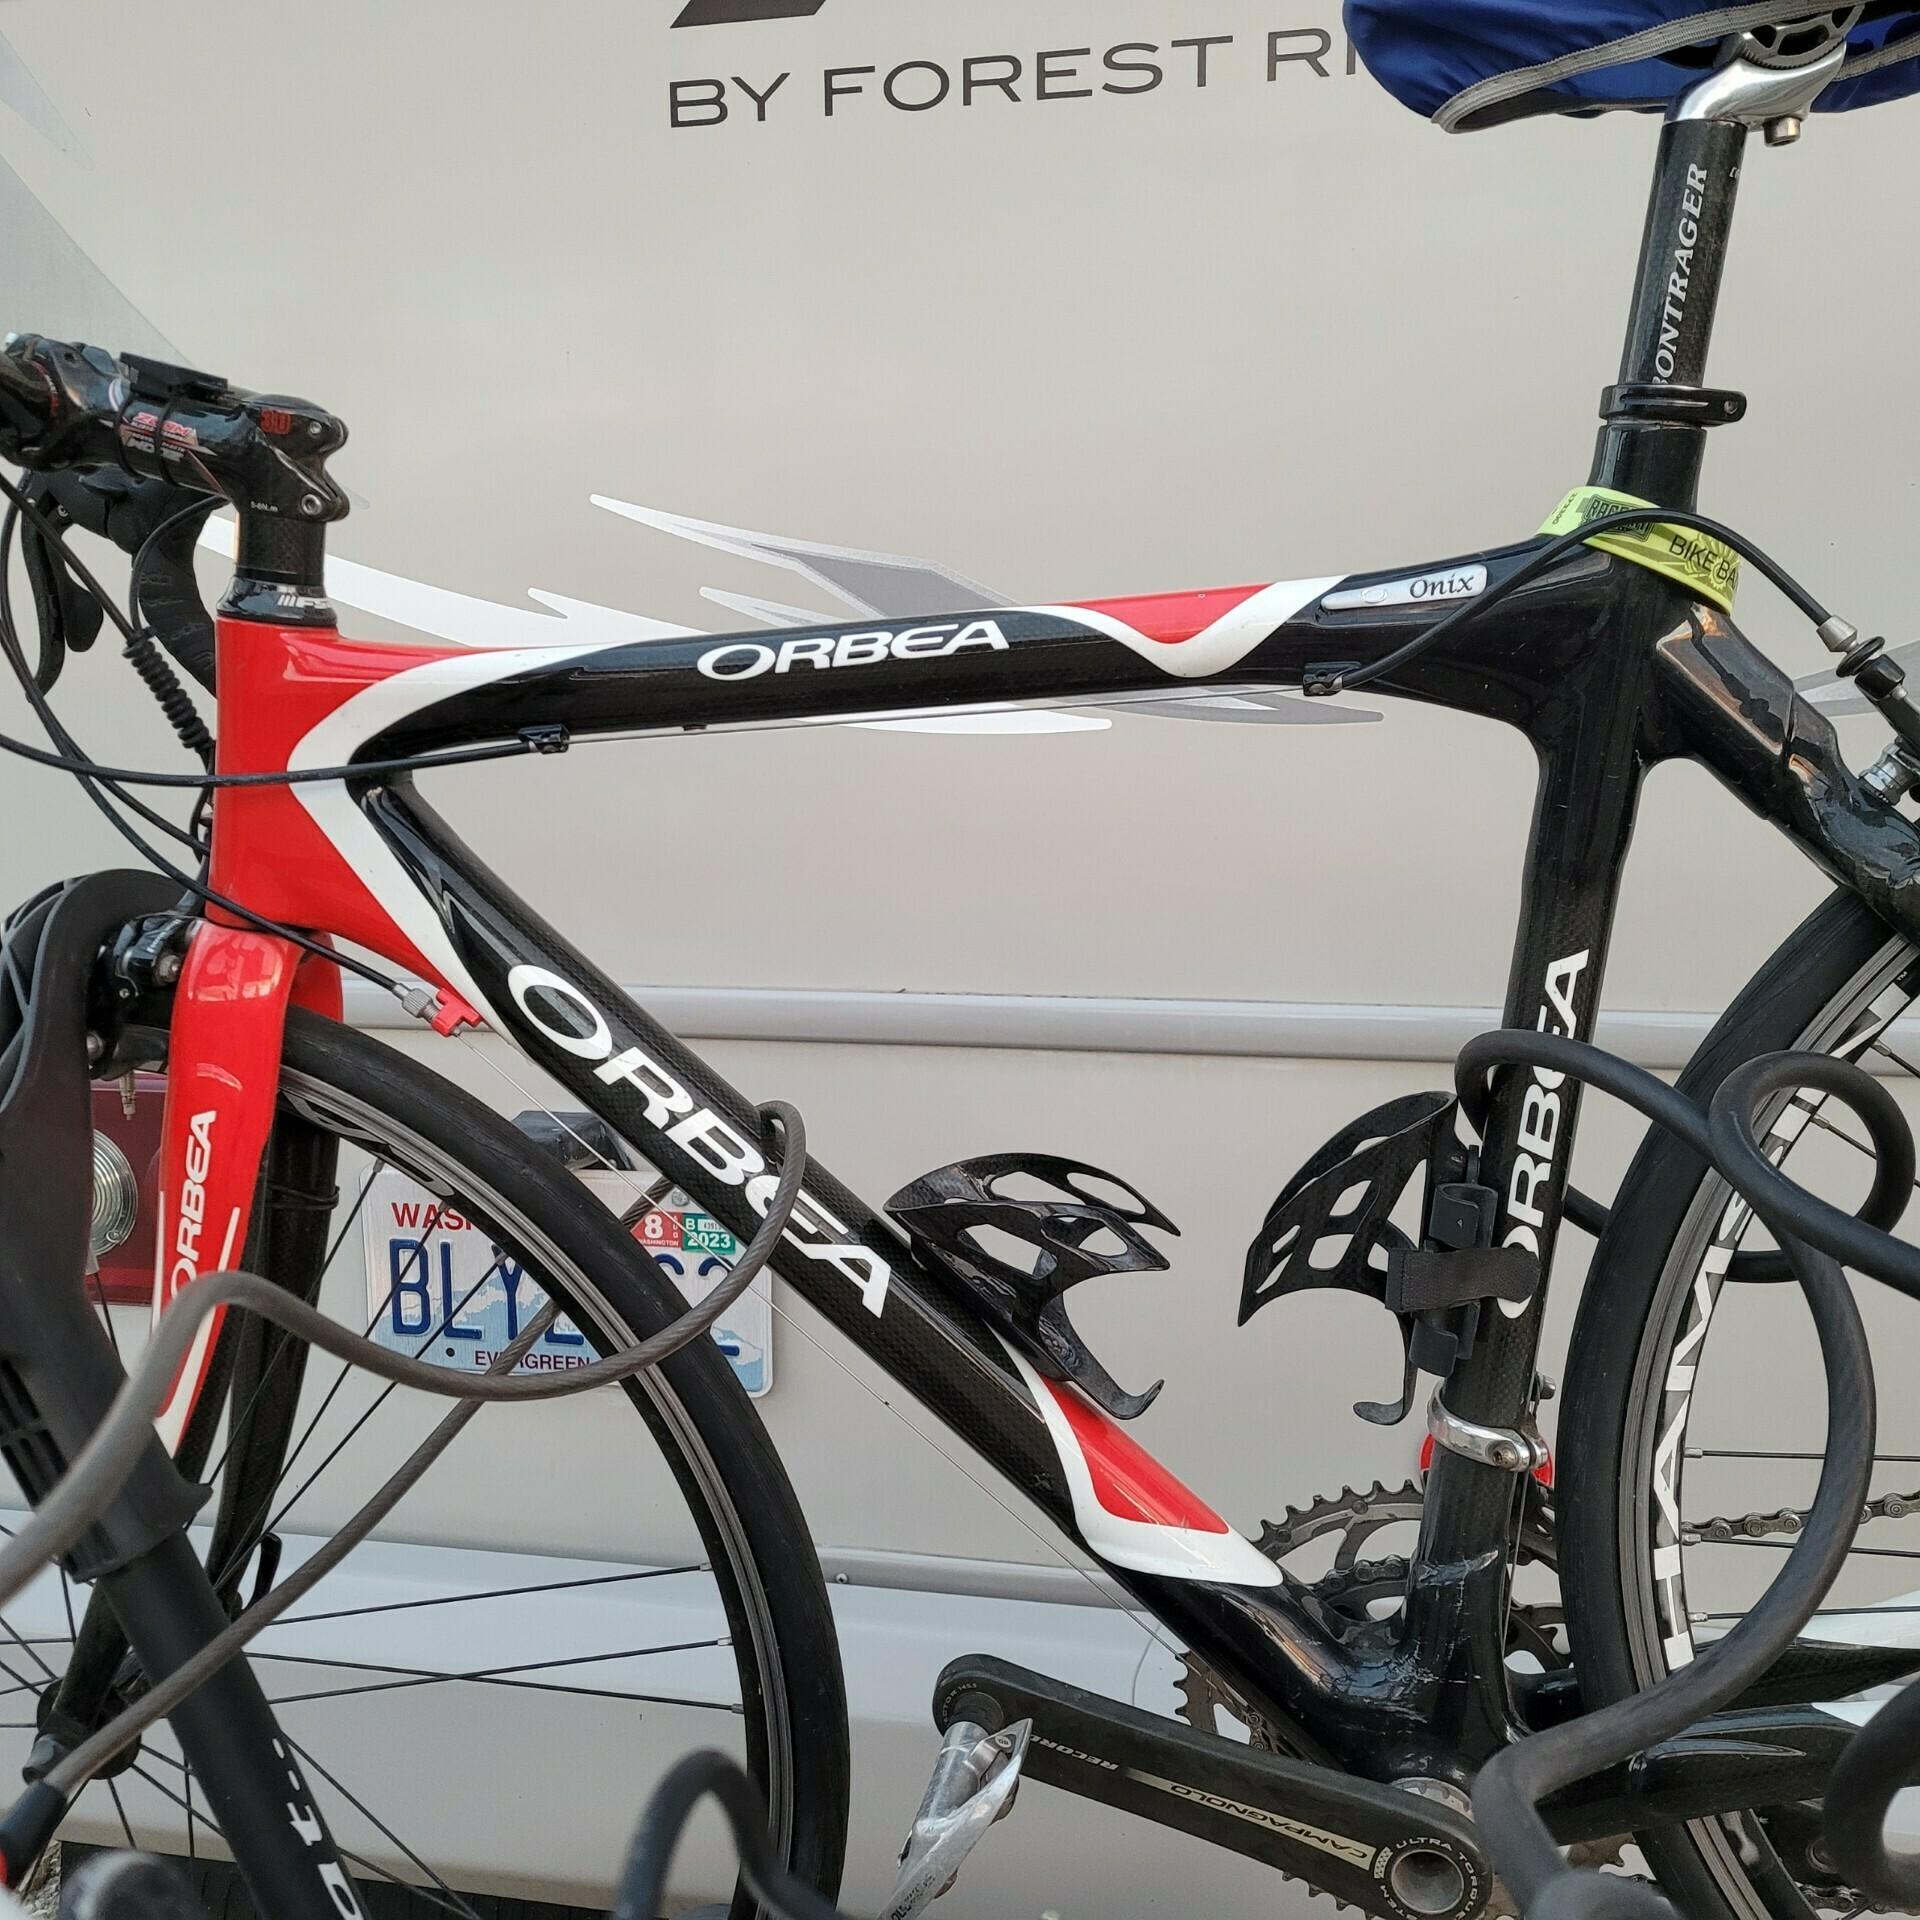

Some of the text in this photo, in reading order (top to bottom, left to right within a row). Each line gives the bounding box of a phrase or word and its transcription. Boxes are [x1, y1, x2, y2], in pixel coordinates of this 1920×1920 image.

[669, 27, 1356, 128] BY FOREST RI
[1409, 572, 1476, 599] Onix
[1668, 534, 1737, 591] BIKE BA
[696, 618, 1010, 681] ORBEA
[506, 963, 893, 1319] ORBEA
[172, 1109, 217, 1298] ORBEA
[644, 1214, 664, 1239] 8
[685, 1218, 696, 1230] B
[687, 1232, 731, 1249] 2023
[1170, 1784, 1369, 1861] CAMPAGNOLO
[1395, 1836, 1453, 1852] ULTRA
